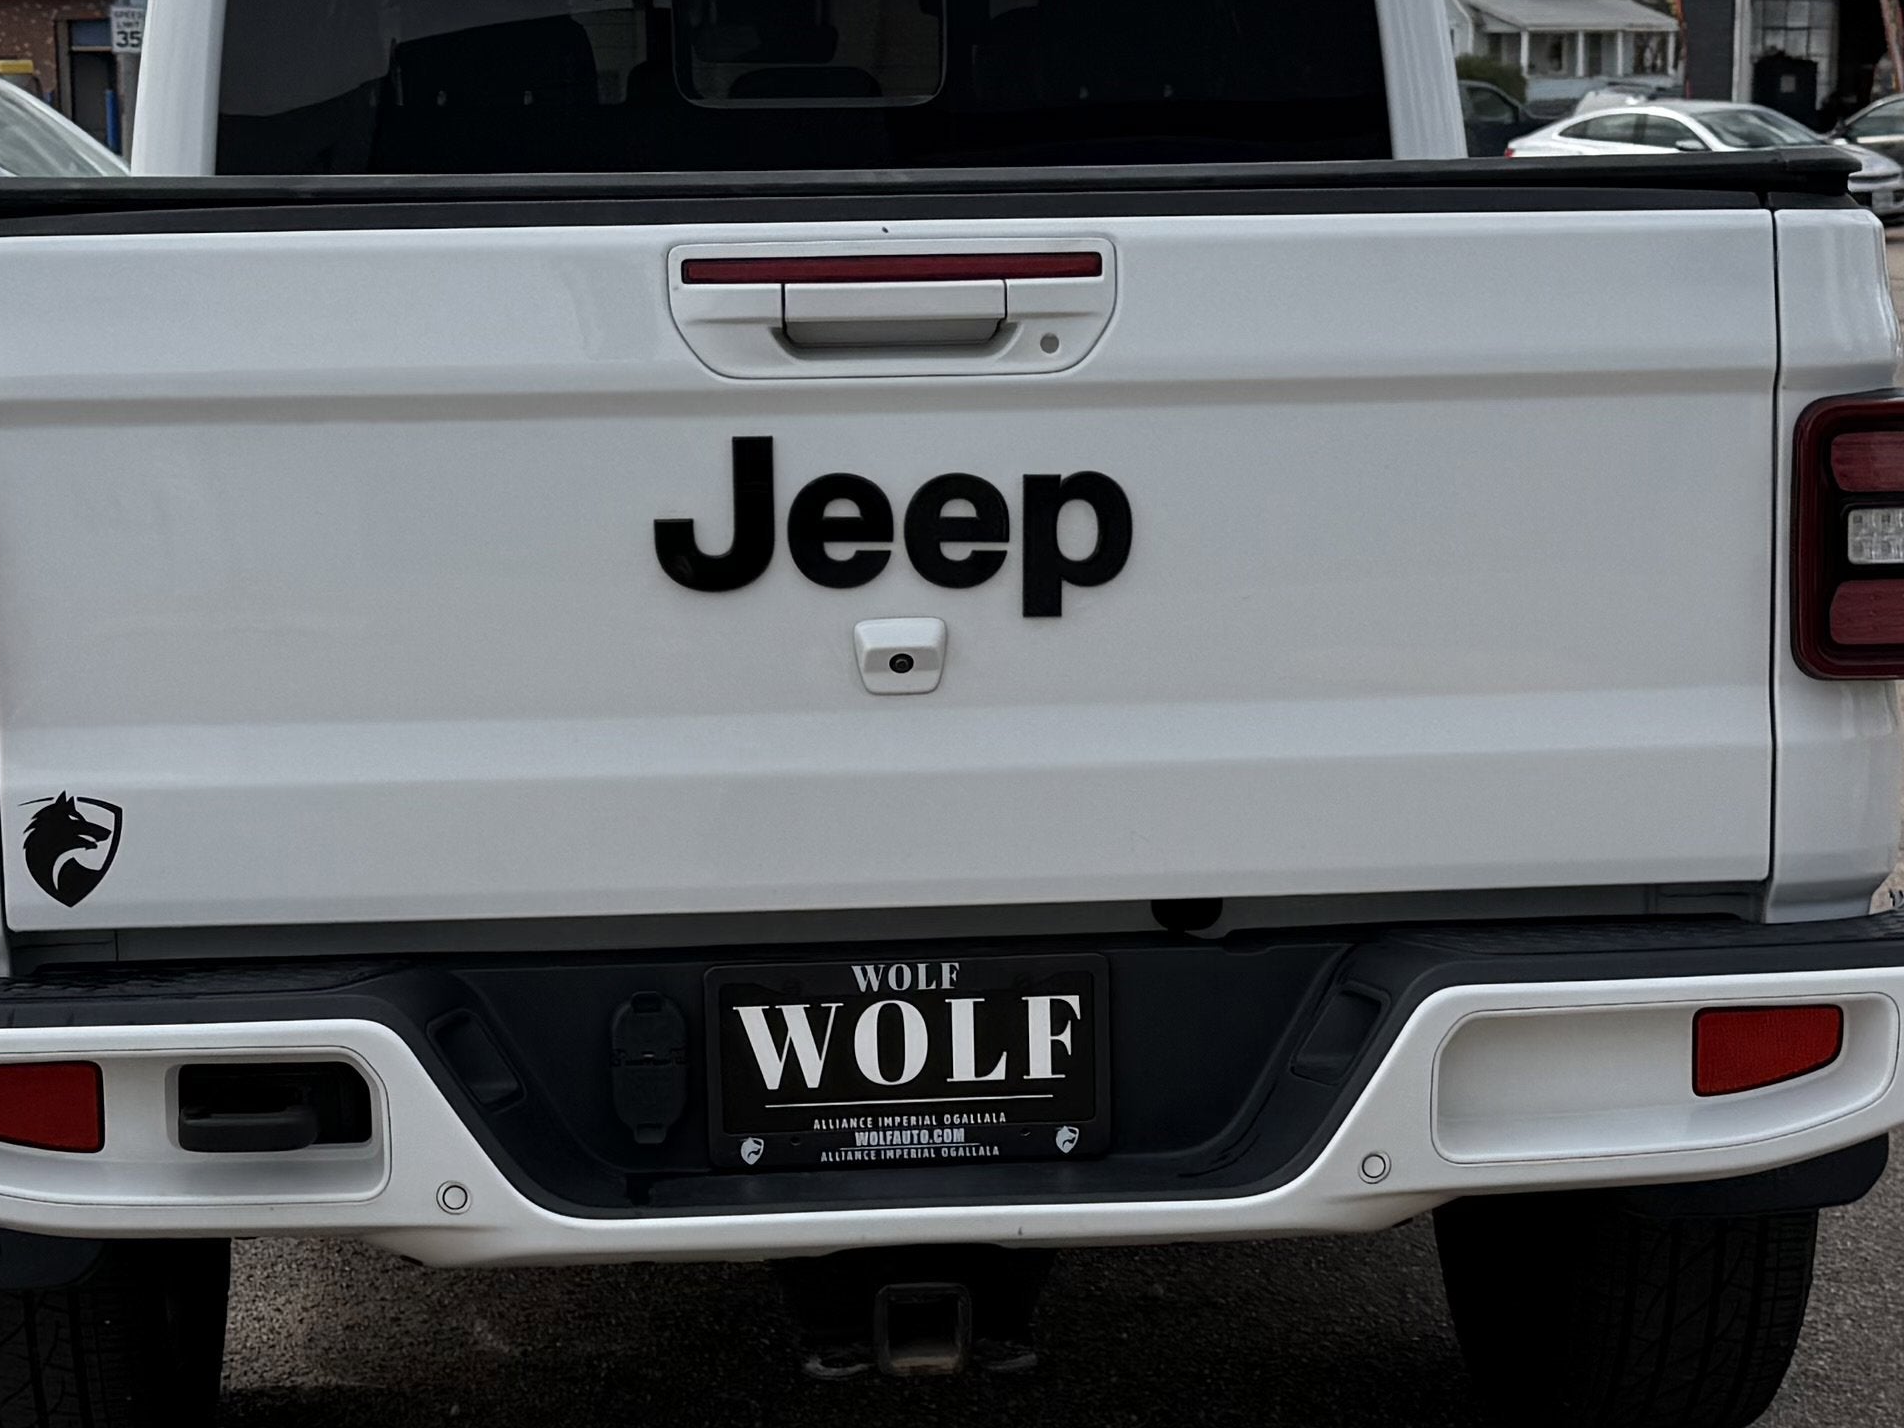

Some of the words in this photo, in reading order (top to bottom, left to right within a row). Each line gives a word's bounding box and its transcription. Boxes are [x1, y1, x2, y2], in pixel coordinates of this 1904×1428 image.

[116, 31, 142, 48] 35
[654, 436, 1133, 618] Jeep
[852, 963, 960, 992] WOLF
[733, 995, 1081, 1090] WOLF
[814, 1118, 873, 1130] ALLIANCE
[879, 1115, 937, 1127] IMPERIAL
[944, 1112, 1006, 1124] OGALLALA
[855, 1128, 965, 1146] WOLFAUTO.COM
[821, 1150, 876, 1162] ALLIANCE
[882, 1148, 935, 1159] IMPERIAL
[942, 1146, 999, 1157] OGALLALA
